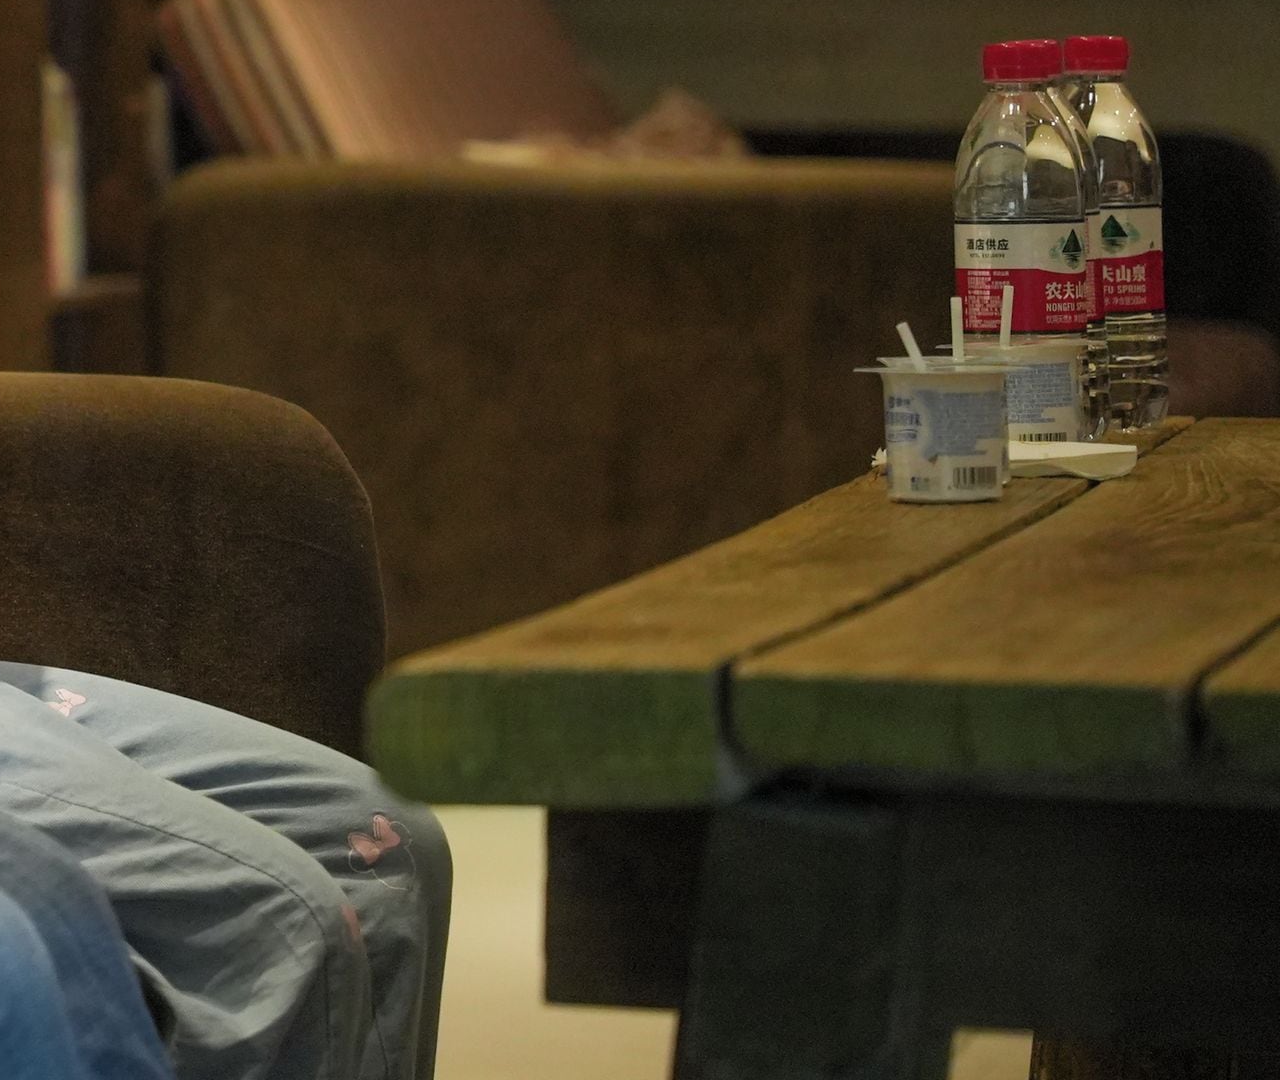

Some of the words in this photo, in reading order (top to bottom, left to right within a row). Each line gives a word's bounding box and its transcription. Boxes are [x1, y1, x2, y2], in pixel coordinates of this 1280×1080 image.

[966, 238, 1010, 251] 酒店供应
[1117, 284, 1146, 294] SPRING
[1046, 303, 1076, 312] NONGFU
